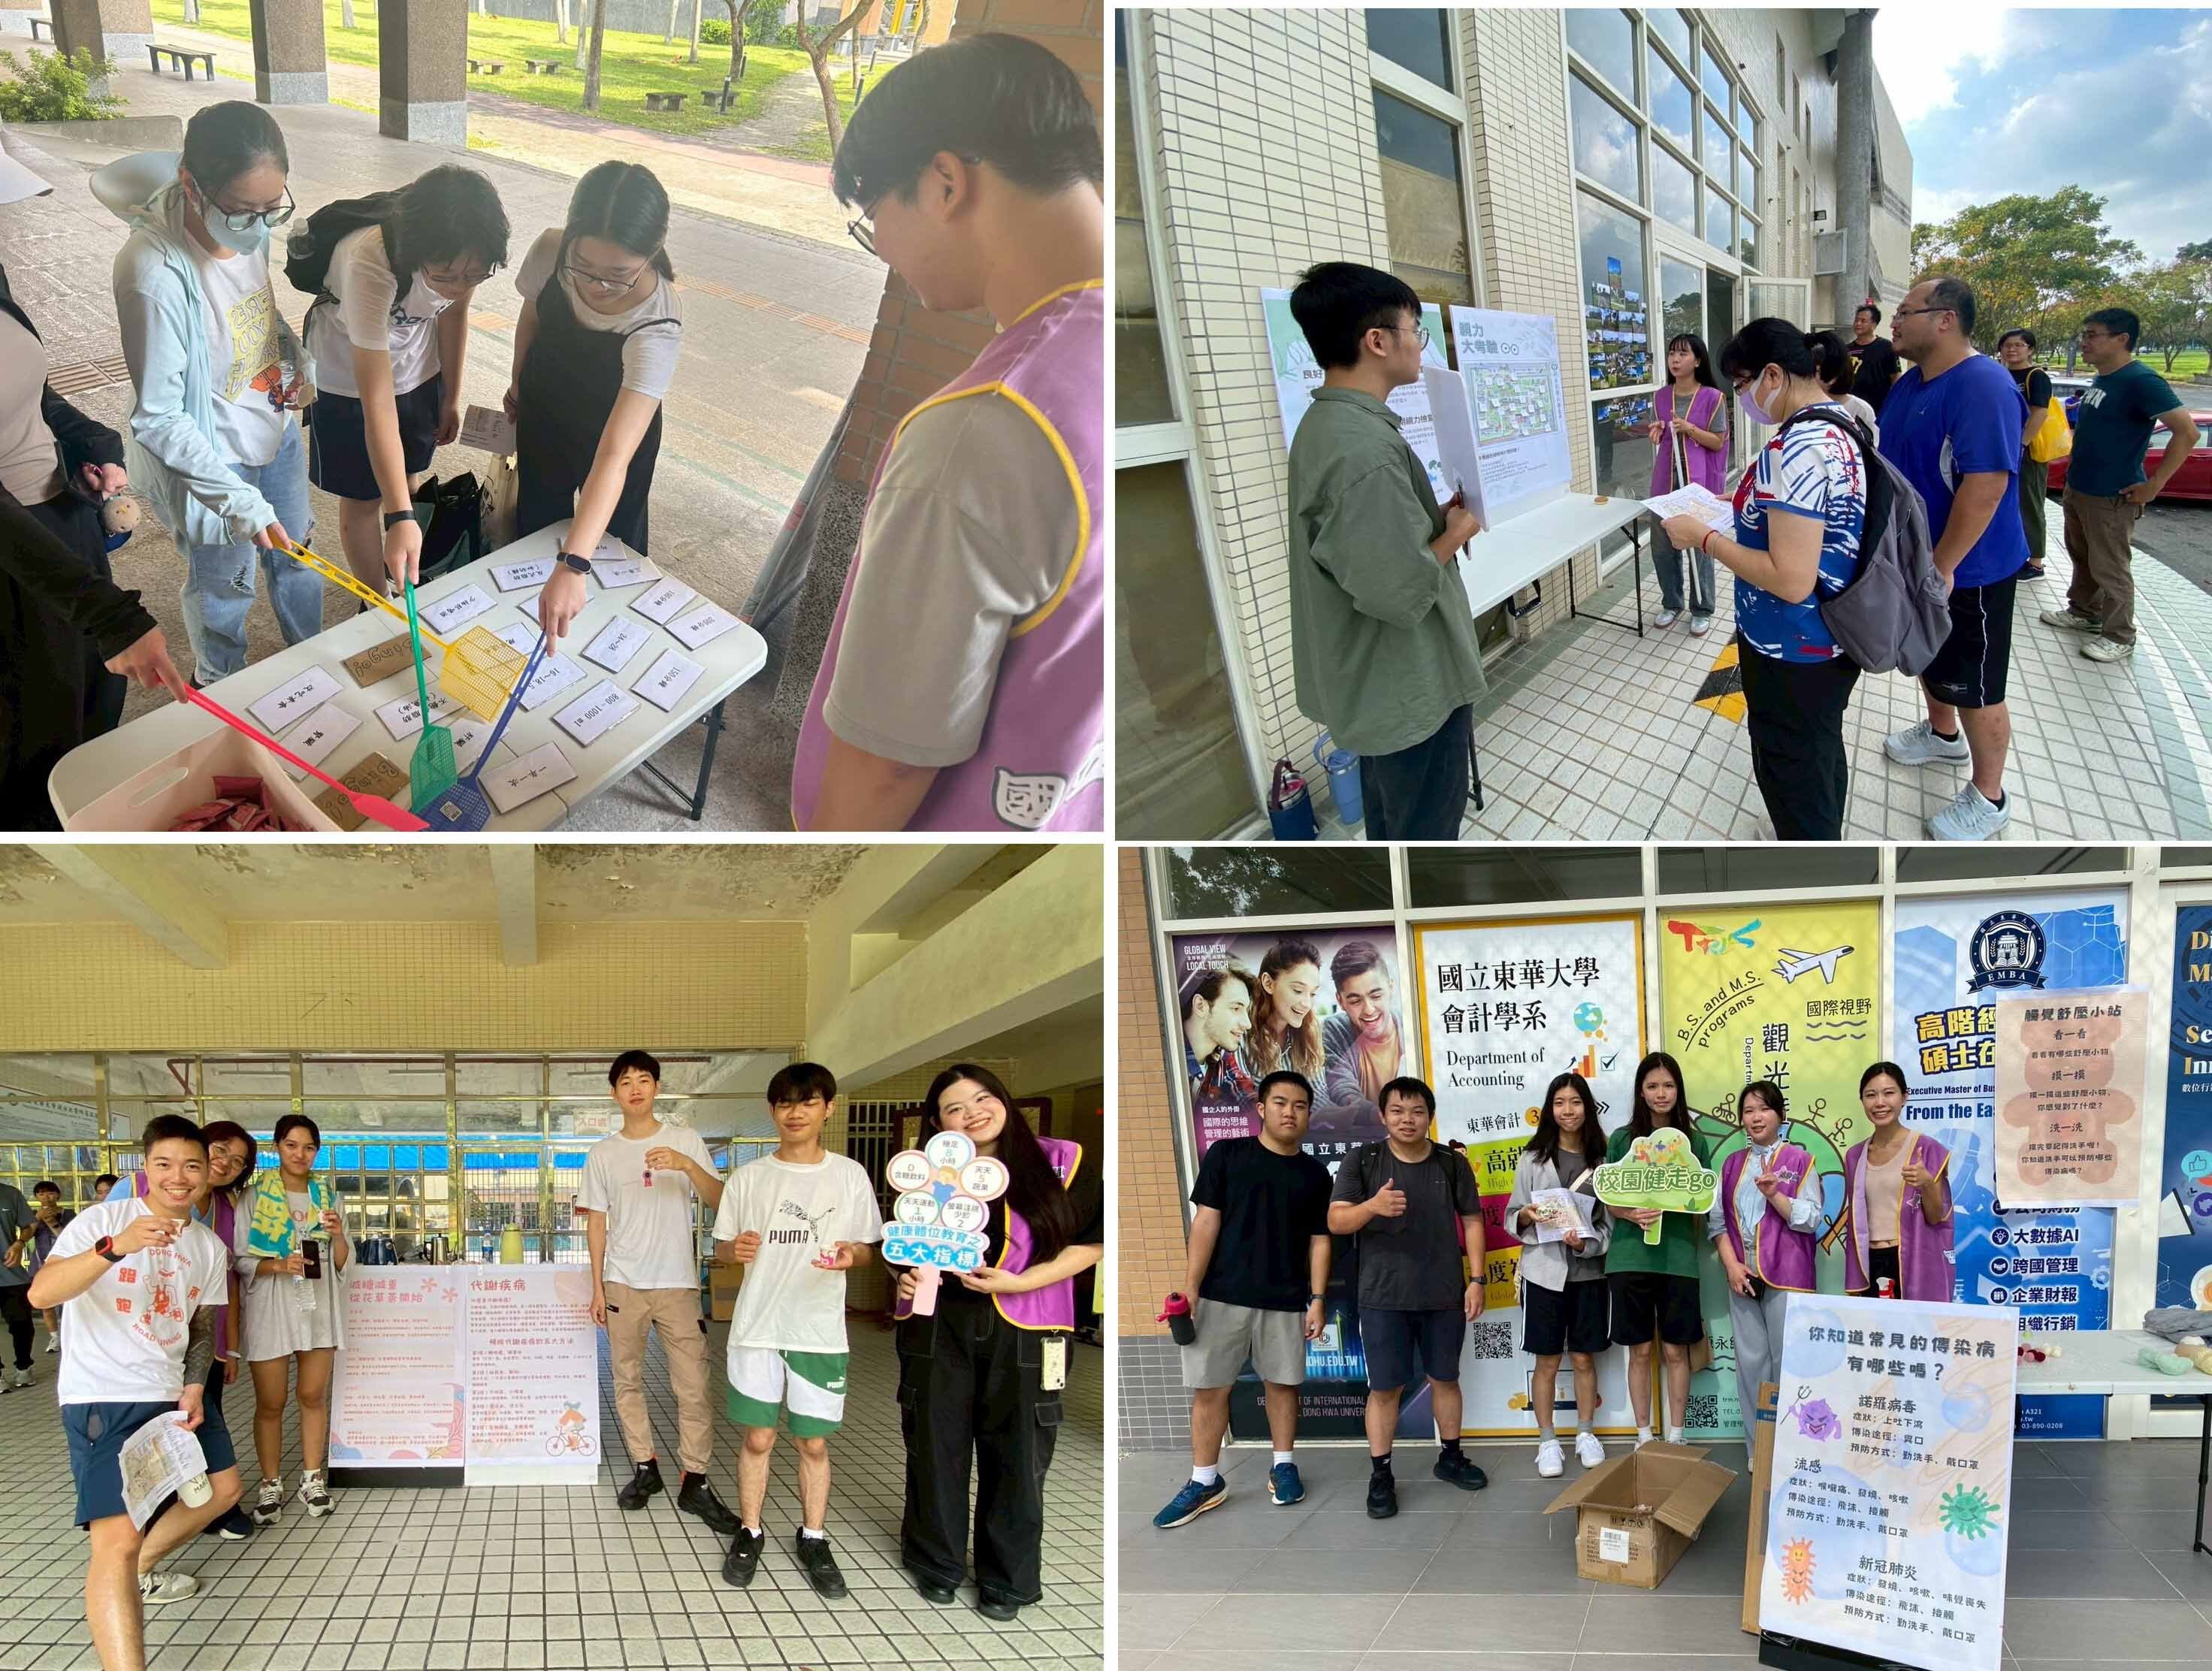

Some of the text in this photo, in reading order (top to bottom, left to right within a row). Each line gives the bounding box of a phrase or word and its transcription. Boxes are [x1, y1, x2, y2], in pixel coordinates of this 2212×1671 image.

[1304, 370, 1323, 379] 良好
[402, 698, 448, 724] 不飽脂肪
[1184, 944, 1226, 955] GLOBAL VIEW
[1187, 960, 1228, 971] LOCAL TOUCH
[2188, 965, 2212, 982] M
[1438, 956, 1600, 993] 國立東華大學
[1988, 971, 2026, 981] EMBA
[1677, 970, 1761, 1041] B.S. and M.S.
[1806, 998, 1872, 1017] 國際視野
[2024, 1005, 2123, 1023] 觸覺舒壓小站
[1441, 1000, 1546, 1034] 會計學系
[1698, 995, 1755, 1048] programs
[2053, 1028, 2087, 1040] 看一看
[1446, 1047, 1545, 1070] Department of
[1448, 1071, 1525, 1091] Accounting
[2050, 1069, 2086, 1080] 摸一摸
[1945, 1086, 1972, 1094] Master
[1974, 1084, 1981, 1092] of
[1906, 1102, 1995, 1120] From the Ea
[1203, 1117, 1249, 1127] 國際的思維
[1467, 1112, 1521, 1135] 東華會計
[2050, 1123, 2084, 1133] 洗一洗
[1204, 1128, 1250, 1138] 管理的藝術
[975, 1165, 992, 1174] 天天
[1596, 1166, 1717, 1193] 校園健走go
[958, 1219, 964, 1228] 2
[769, 1230, 809, 1243] PUMA
[888, 1225, 981, 1248] 健康體位教育之
[2014, 1228, 2079, 1244] 大數據AI
[889, 1242, 976, 1267] 五大指標
[2012, 1257, 2078, 1274] 跨國管理
[470, 1278, 527, 1292] 代謝疾病
[2012, 1286, 2078, 1303] 企業財報
[157, 1331, 182, 1346] UNNING
[1809, 1326, 1996, 1358] 你知道常見的傳染病
[1304, 1397, 1311, 1405] OF
[1314, 1396, 1365, 1405] INTERNATIONAL
[1858, 1395, 1917, 1414] 諾羅病毒
[1303, 1407, 1365, 1417] DONG HWA UNIVER
[1794, 1457, 1822, 1473] 流感
[1858, 1555, 1917, 1580] 新冠肺炎
